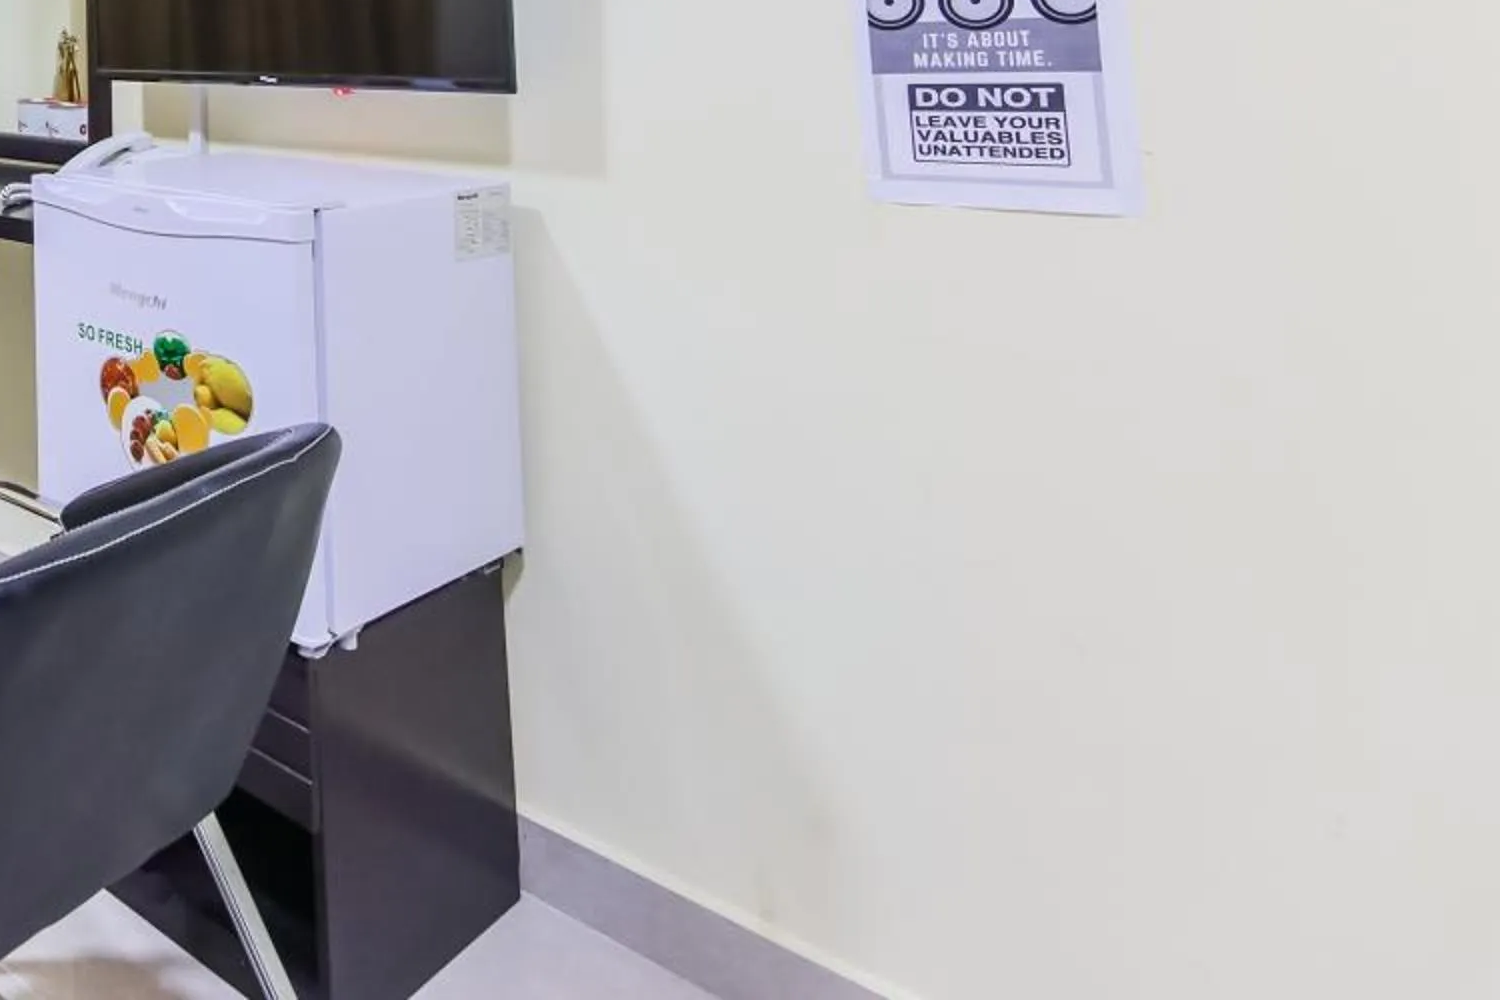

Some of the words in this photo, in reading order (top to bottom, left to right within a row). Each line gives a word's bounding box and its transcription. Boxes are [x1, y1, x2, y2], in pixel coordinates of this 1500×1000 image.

[922, 32, 959, 49] IT'S
[967, 29, 1031, 48] ABOUT
[913, 51, 989, 69] MAKING
[996, 49, 1052, 67] TIME.
[915, 87, 967, 108] DO
[977, 87, 1056, 108] NOT
[915, 115, 987, 128] LEAVE
[993, 116, 1061, 130] YOUR
[917, 130, 1064, 145] VALUABLES
[918, 144, 1065, 160] UNATTENDED
[78, 321, 96, 341] SO
[98, 327, 143, 354] FRESH
